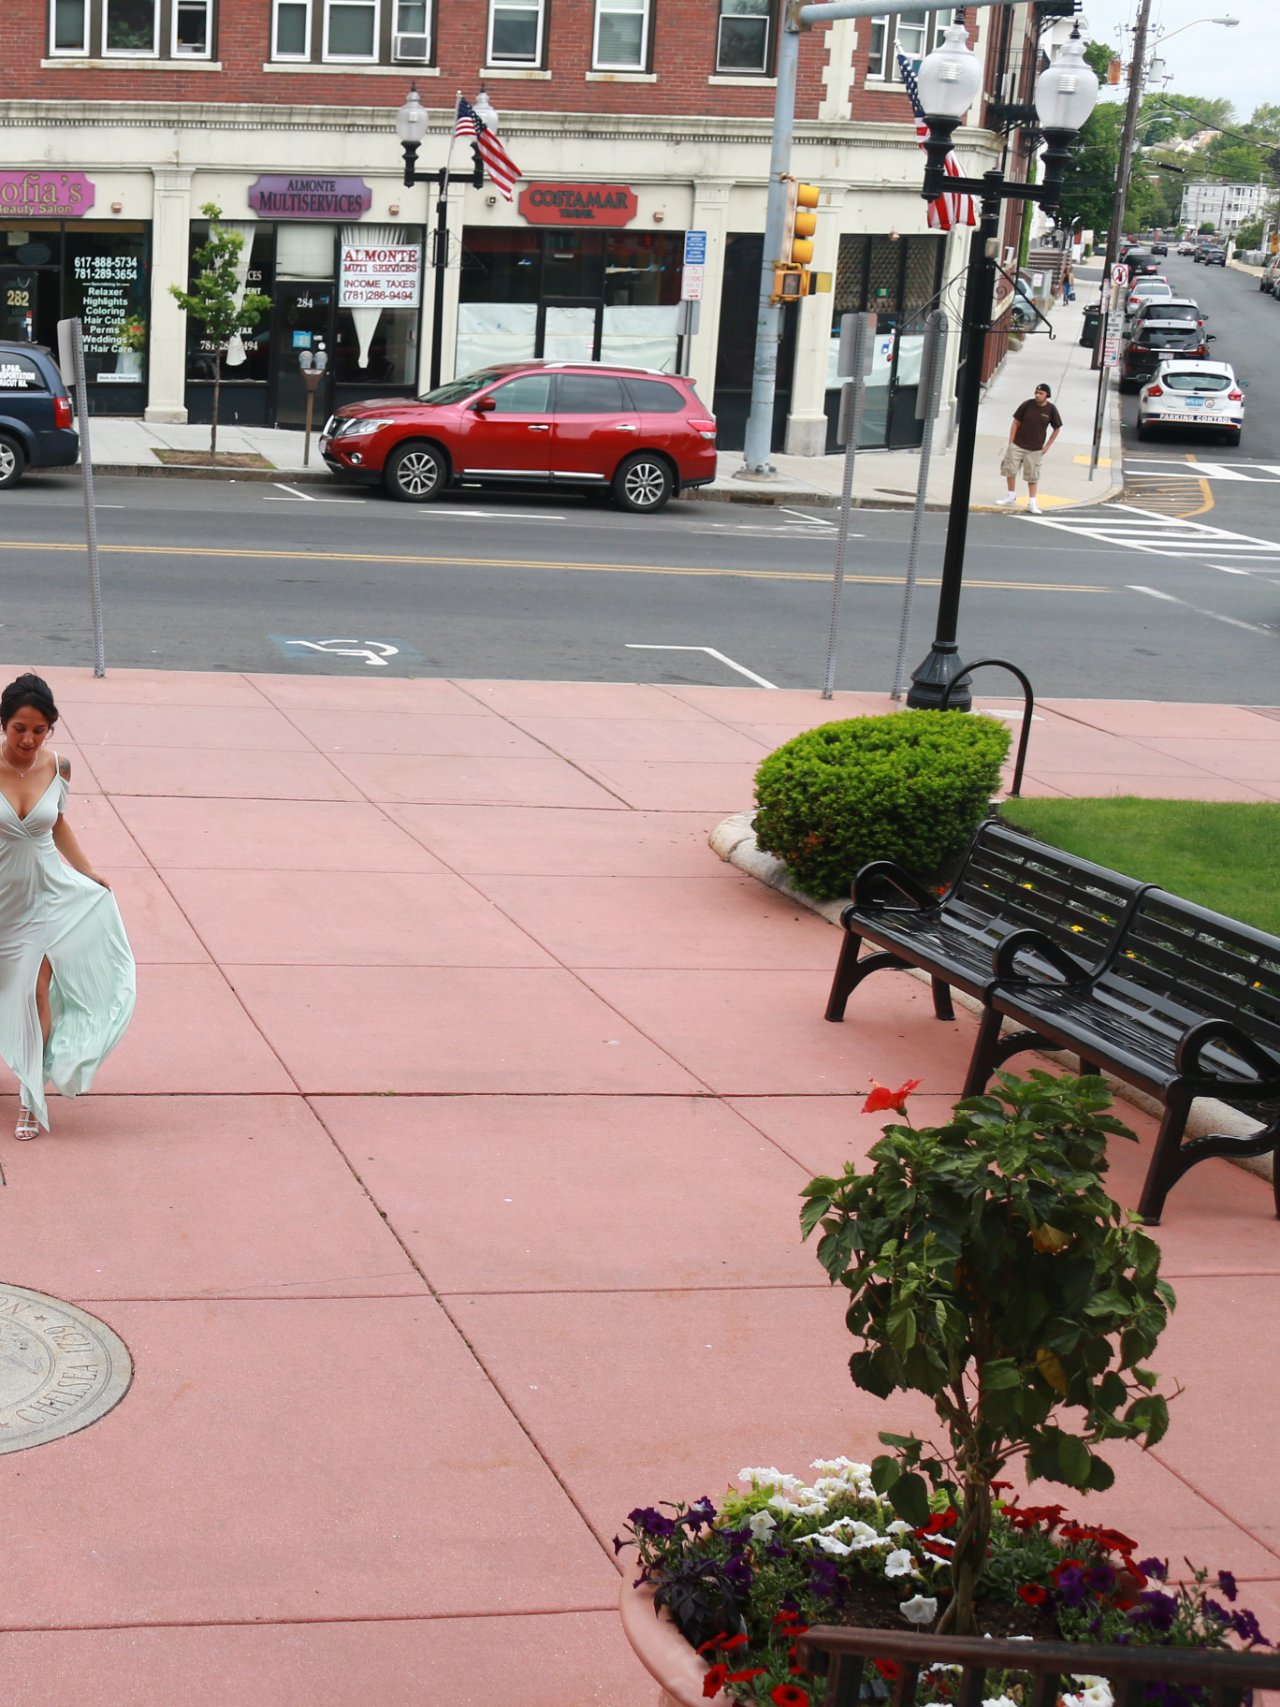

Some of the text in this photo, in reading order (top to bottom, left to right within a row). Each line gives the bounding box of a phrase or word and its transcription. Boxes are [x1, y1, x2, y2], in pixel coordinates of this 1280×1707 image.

[287, 180, 336, 192] ALMONTE
[259, 191, 363, 212] MULTISERVICES
[530, 189, 628, 209] COSTAMAR
[39, 203, 73, 214] Salon
[343, 249, 418, 263] ALMONTE
[74, 256, 138, 268] 617-888-5734
[344, 264, 417, 272] MUTI SERVICES
[74, 268, 138, 280] 781-289-3654
[344, 280, 416, 288] INCOME TAXES
[88, 287, 123, 296] Relaxer
[343, 290, 413, 302] (781)286-9494
[7, 290, 30, 306] 282
[83, 297, 128, 307] Highlights
[297, 297, 314, 308] 284
[85, 306, 126, 317] Coloring
[84, 316, 126, 325] Hair Cuts
[90, 325, 120, 334] Perms
[82, 335, 128, 345] Weddings
[90, 345, 109, 353] Hair
[111, 345, 133, 353] Care
[16, 1363, 98, 1424] CHELSEA
